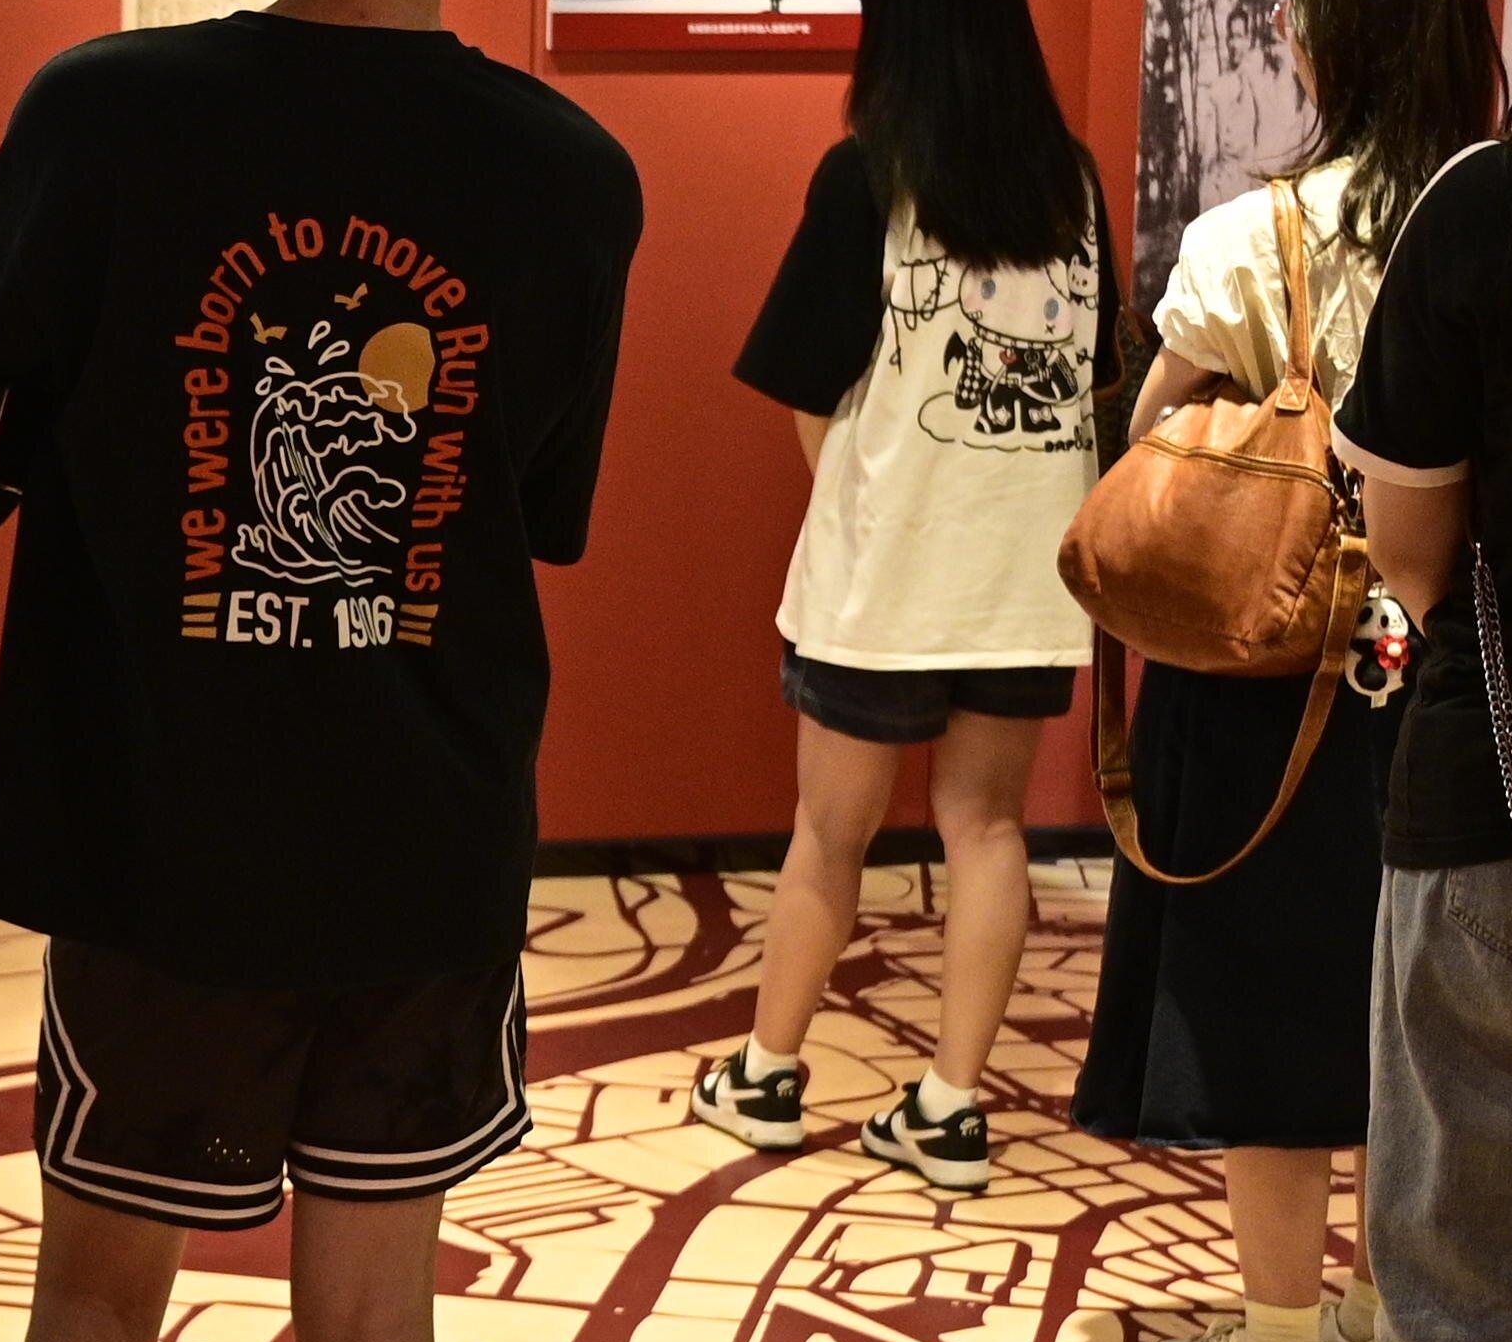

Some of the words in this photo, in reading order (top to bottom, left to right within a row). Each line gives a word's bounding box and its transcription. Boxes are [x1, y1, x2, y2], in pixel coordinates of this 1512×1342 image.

[268, 211, 325, 262] to
[339, 215, 466, 318] move
[175, 238, 265, 355] born
[433, 323, 489, 416] Run
[181, 365, 230, 493] were
[409, 430, 468, 529] with
[181, 508, 226, 582] we
[406, 541, 445, 592] us
[226, 590, 312, 648] EST.
